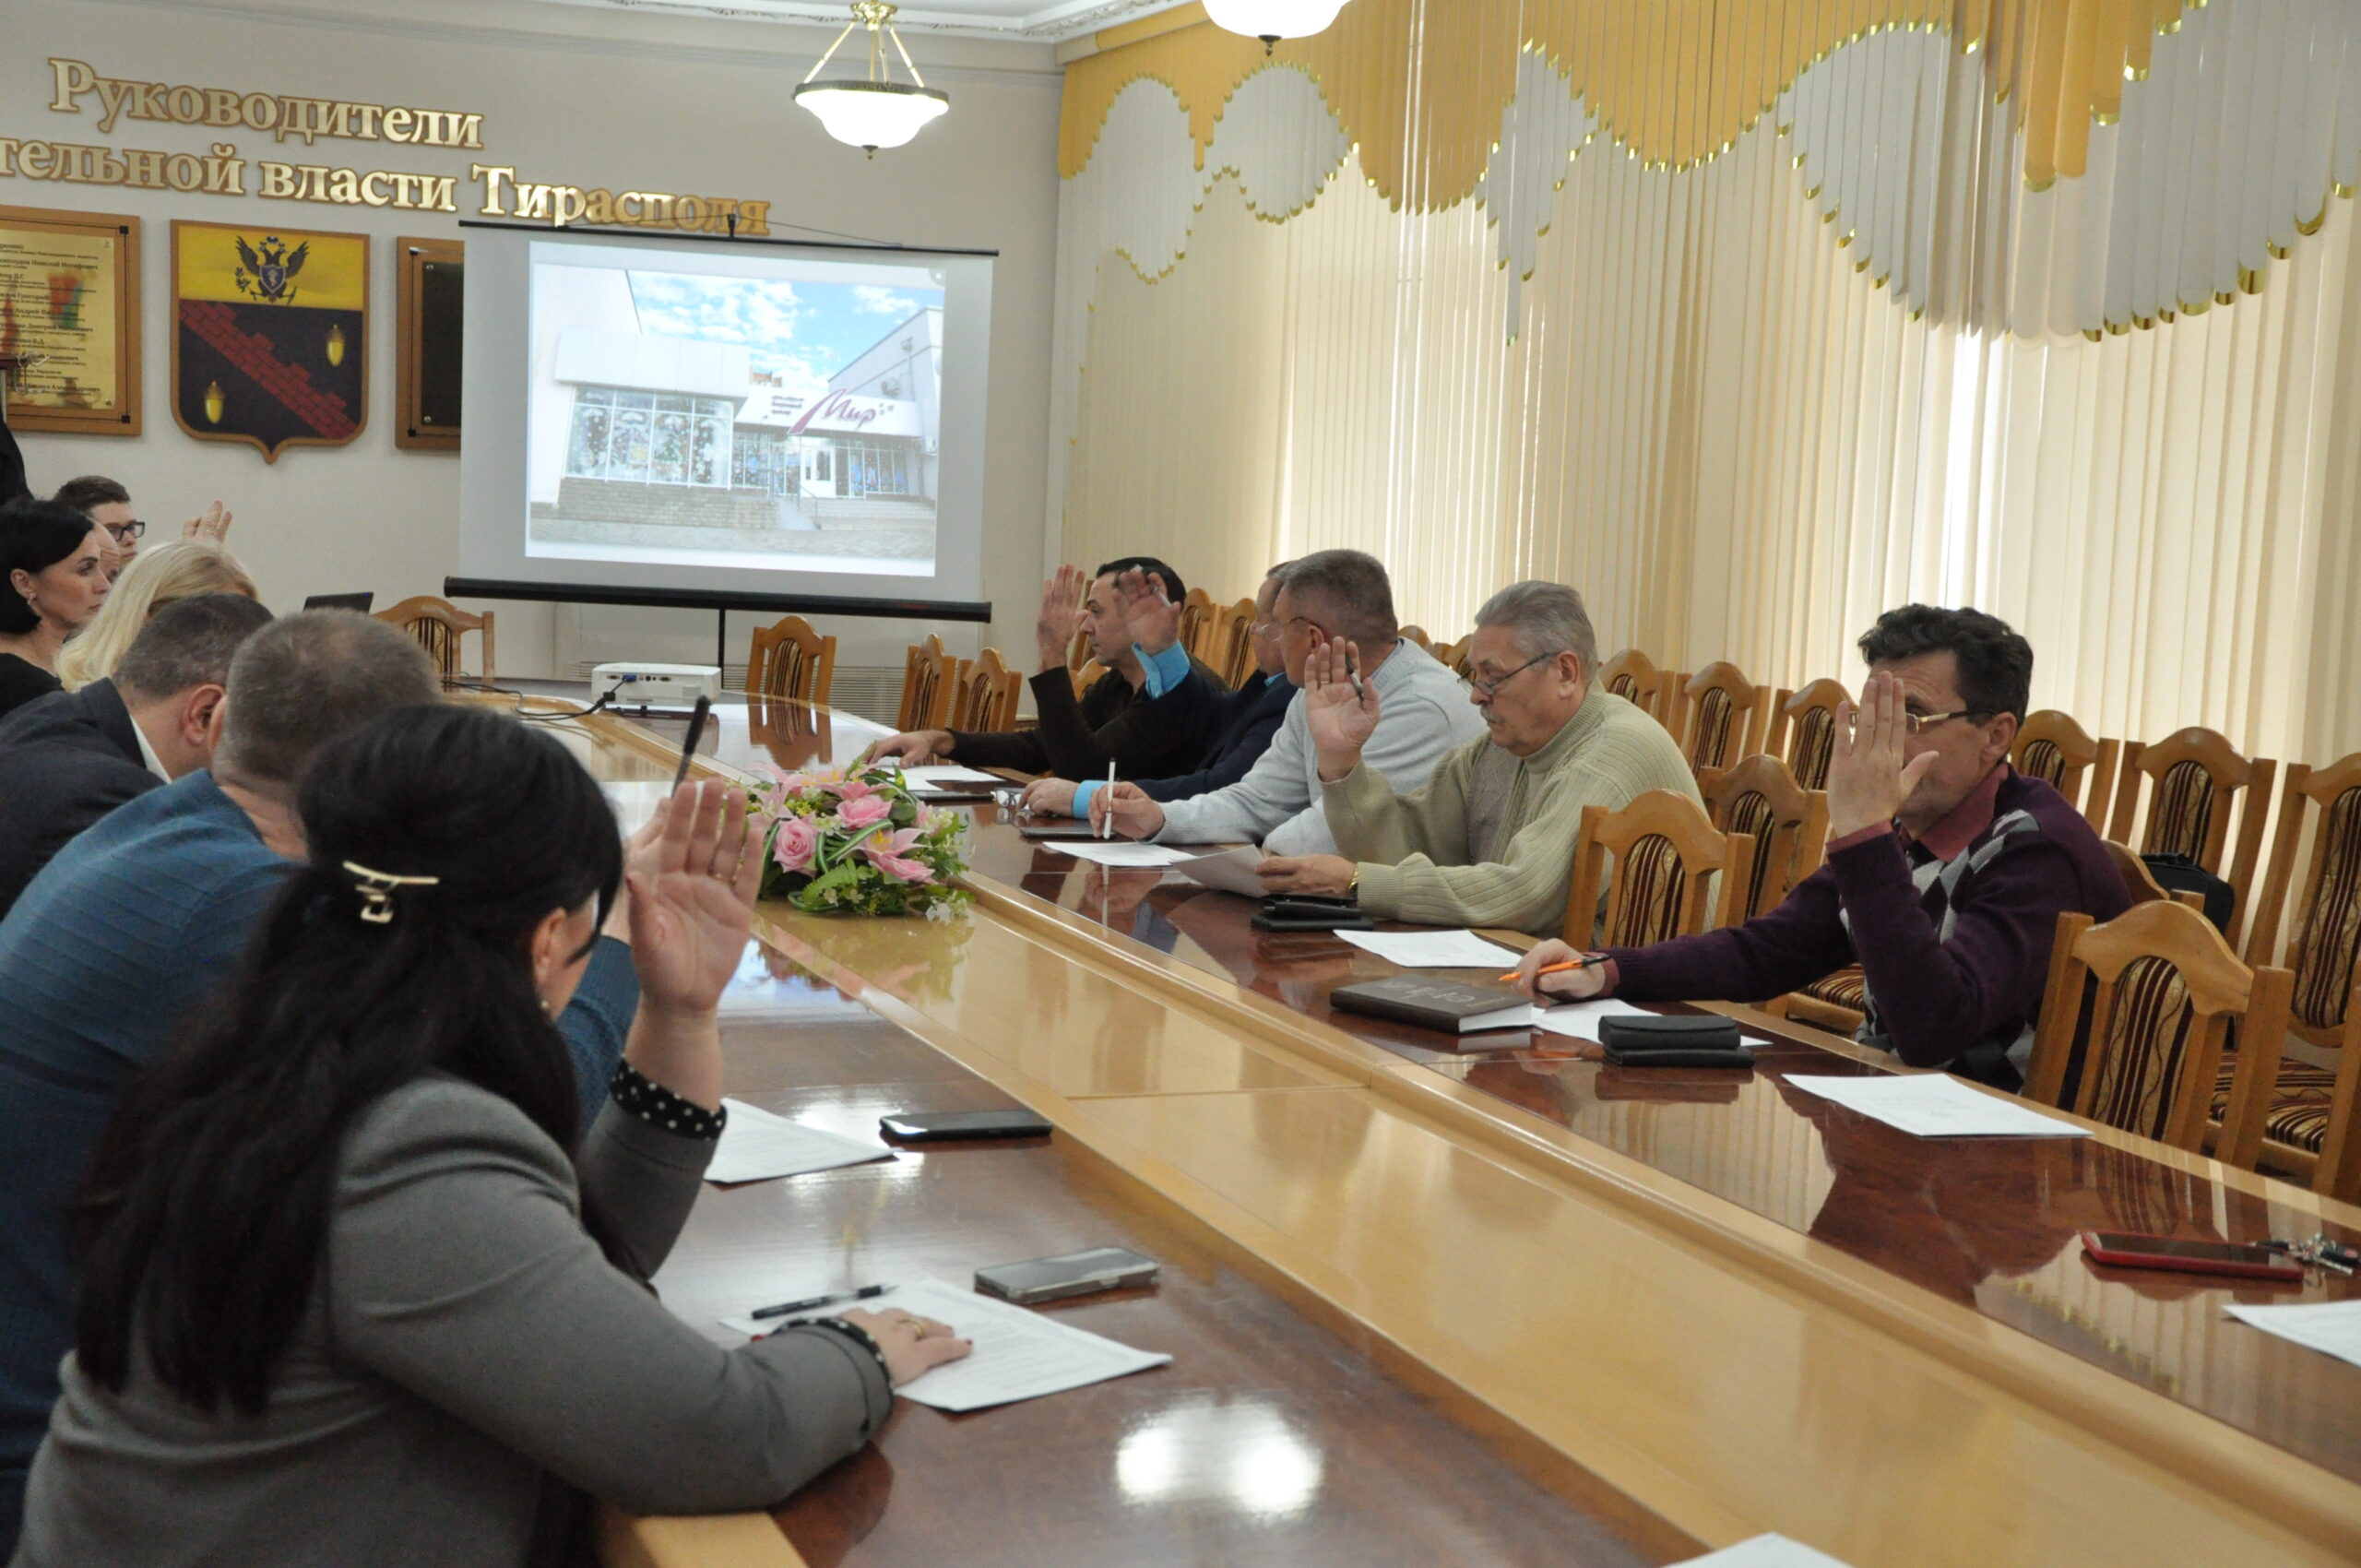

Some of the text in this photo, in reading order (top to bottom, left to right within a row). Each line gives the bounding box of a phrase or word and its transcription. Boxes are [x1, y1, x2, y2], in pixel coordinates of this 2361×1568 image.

[48, 57, 484, 149] Руководители
[258, 160, 458, 212] власти
[471, 163, 771, 236] Тирасполя
[787, 388, 876, 435] Мир
